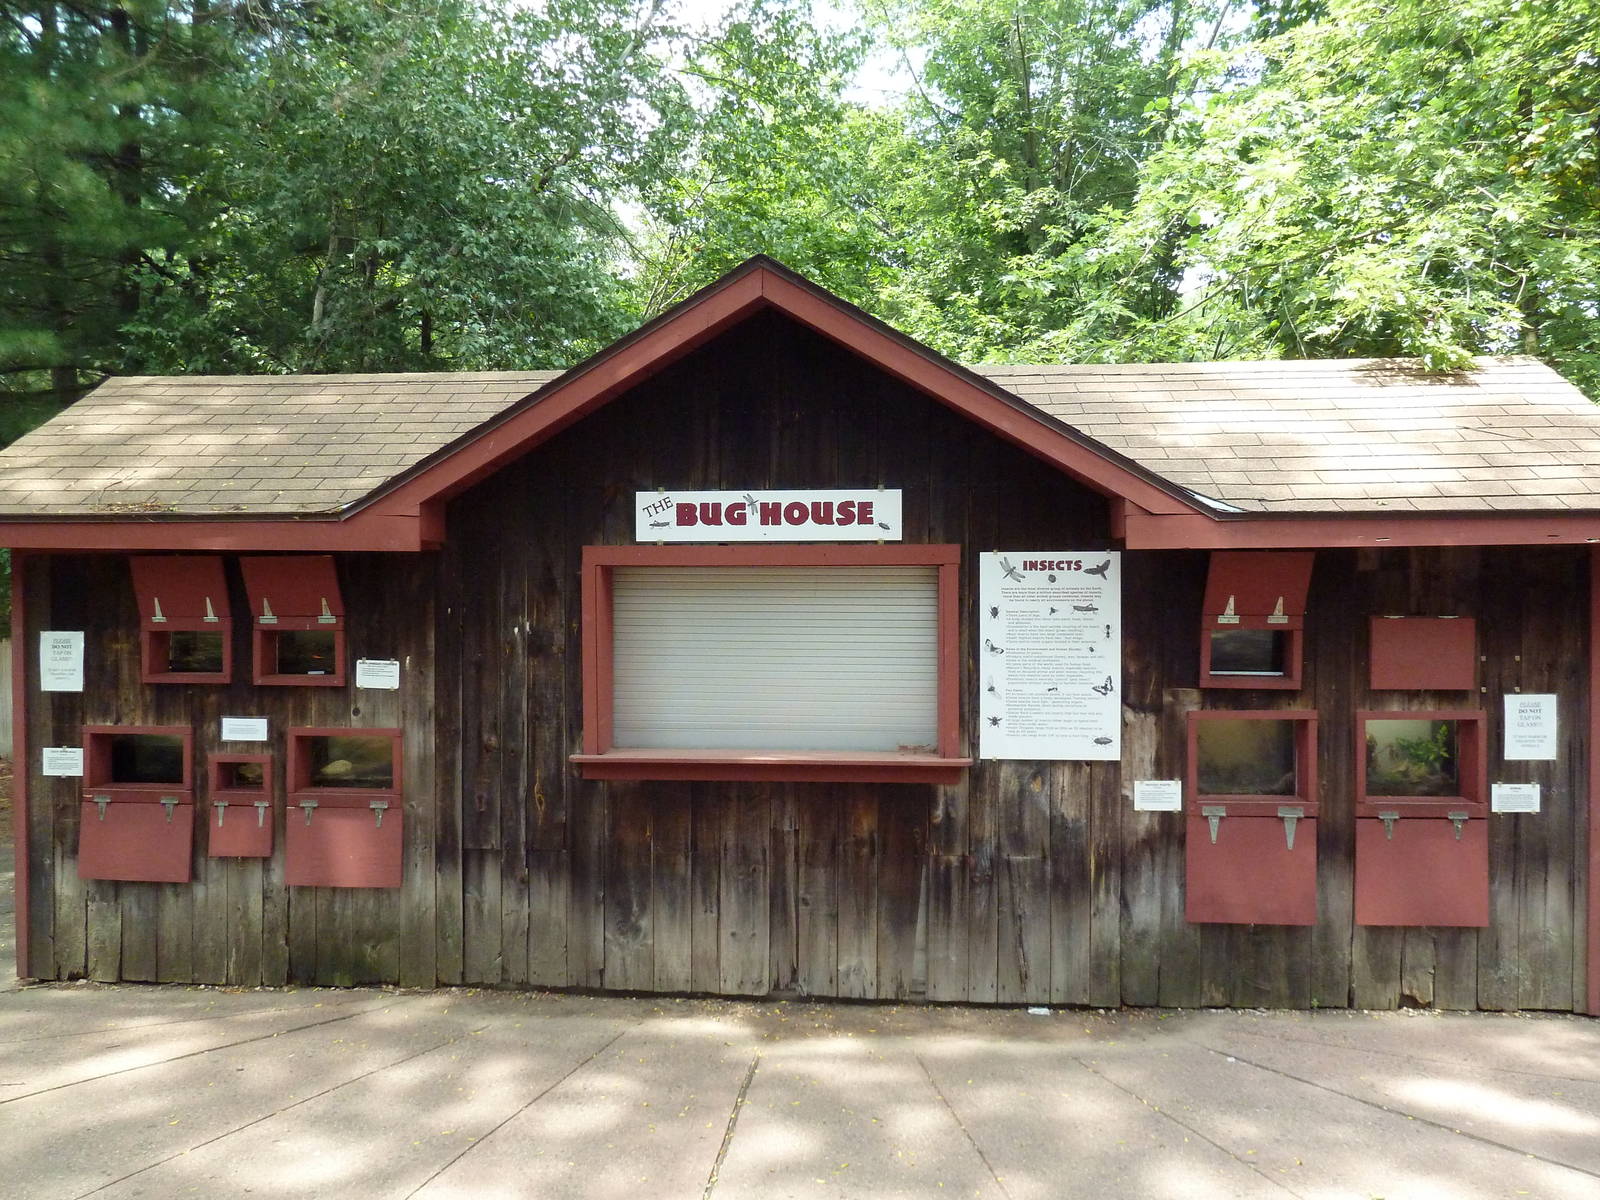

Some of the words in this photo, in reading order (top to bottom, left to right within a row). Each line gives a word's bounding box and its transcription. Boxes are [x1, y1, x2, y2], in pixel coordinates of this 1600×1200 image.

[642, 496, 674, 518] THE
[675, 502, 747, 527] BUG
[759, 500, 875, 527] HOUSE
[1022, 559, 1083, 572] INSECTS
